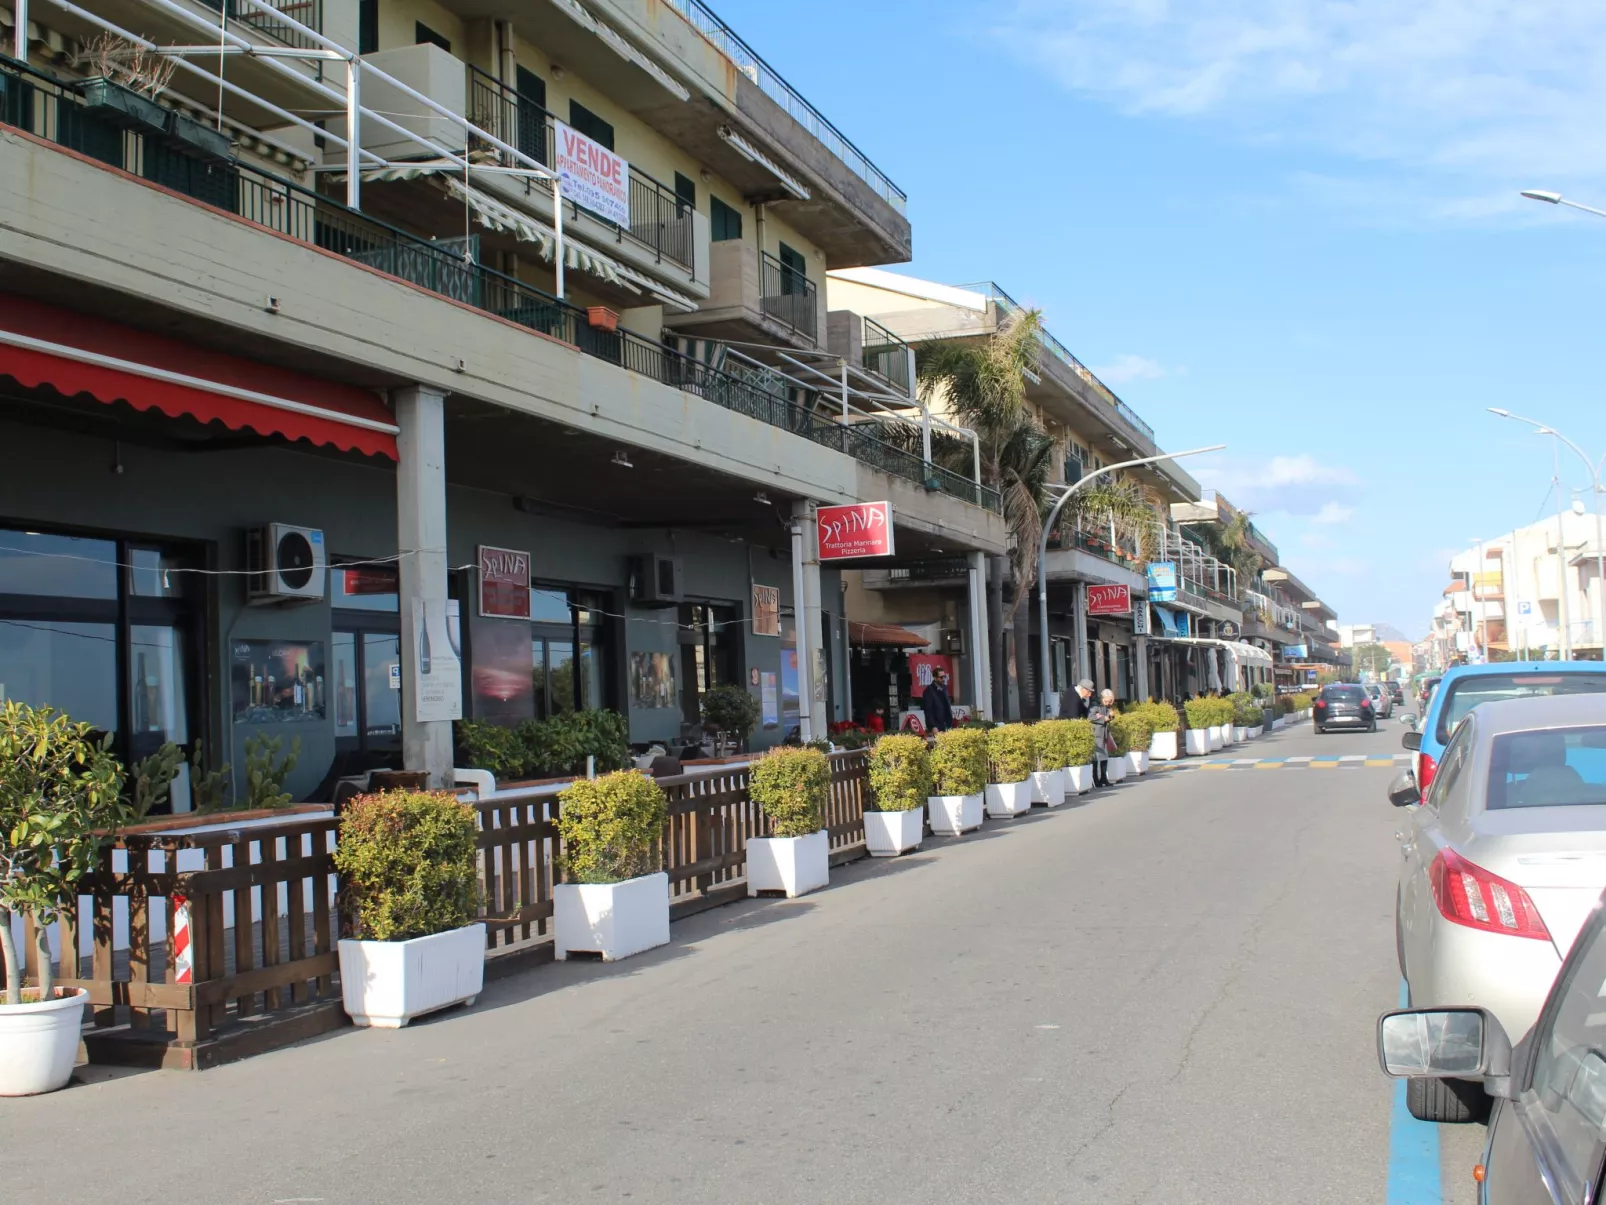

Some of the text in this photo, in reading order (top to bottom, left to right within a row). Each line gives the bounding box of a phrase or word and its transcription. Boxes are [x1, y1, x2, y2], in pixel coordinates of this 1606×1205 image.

[563, 128, 621, 186] VENDE
[819, 507, 885, 544] SPINA
[825, 539, 882, 550] Trattoria Marinara
[841, 548, 866, 556] Pizzeria
[483, 548, 526, 579] SPINA
[1089, 586, 1127, 606] SPINA
